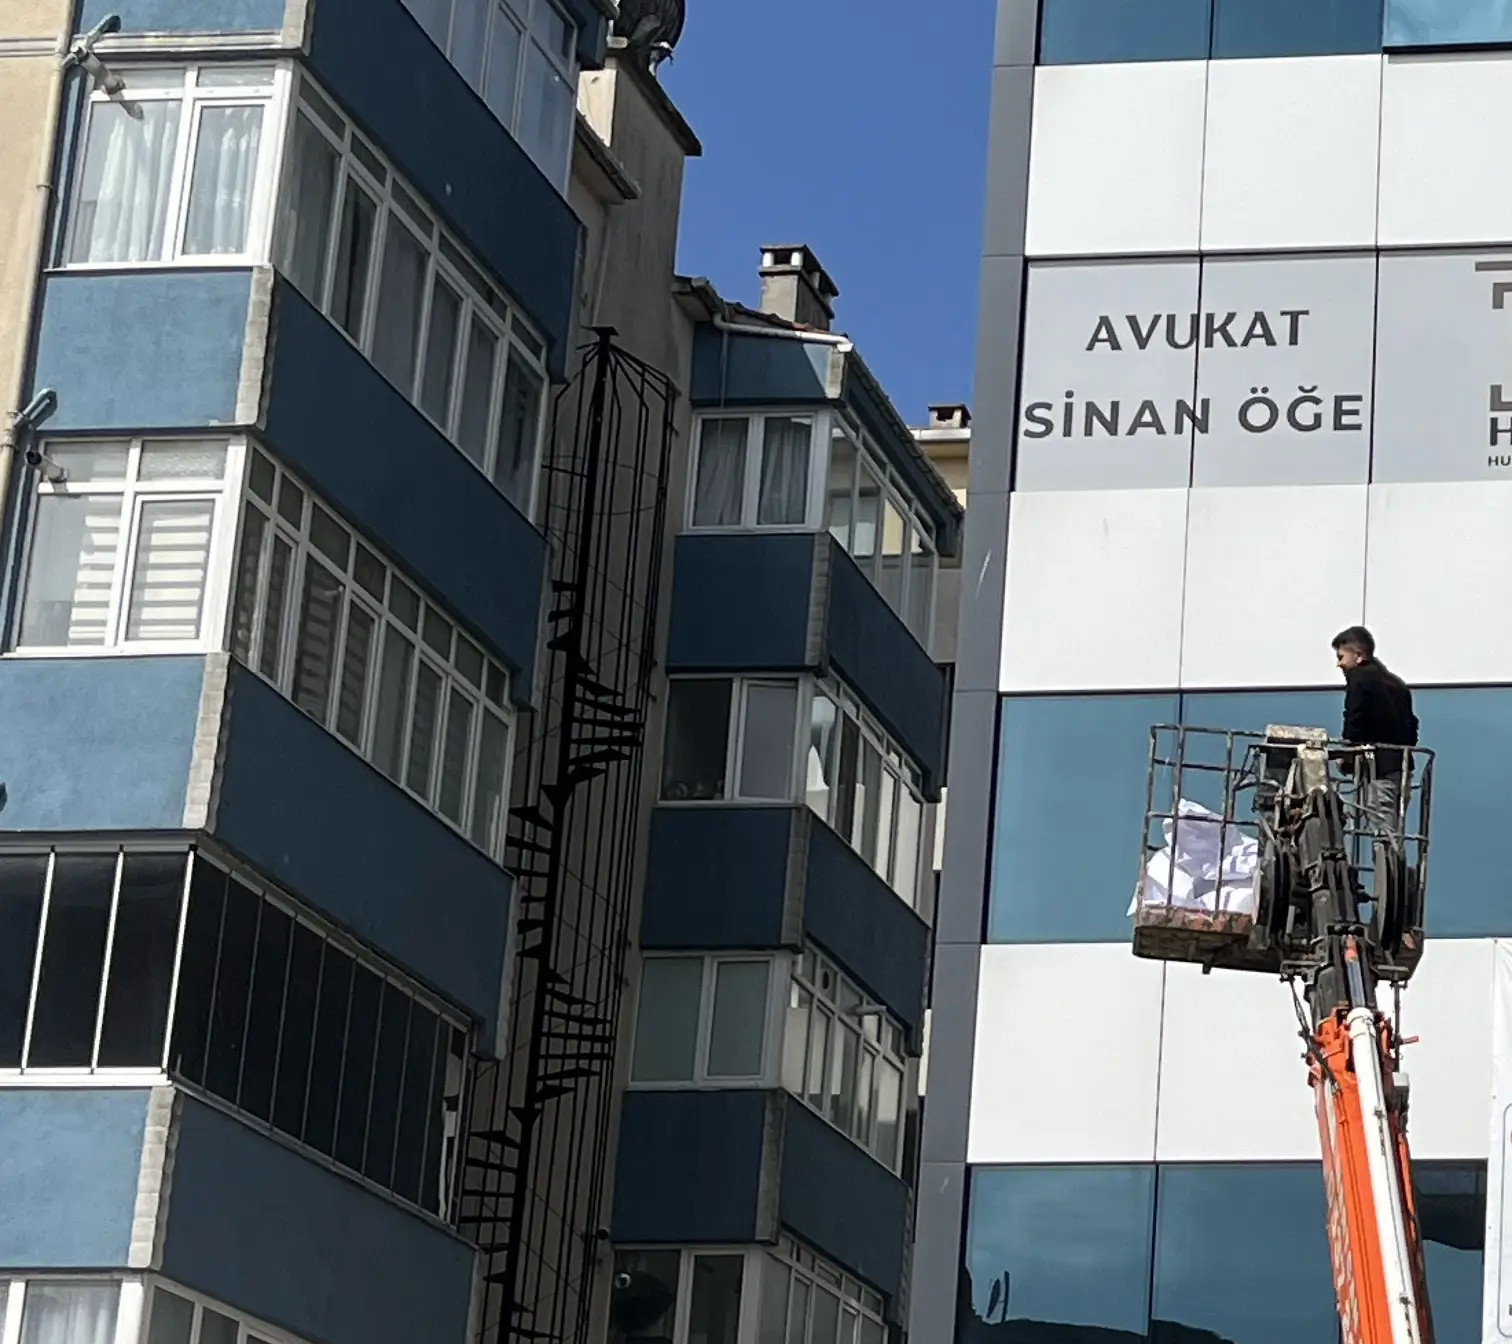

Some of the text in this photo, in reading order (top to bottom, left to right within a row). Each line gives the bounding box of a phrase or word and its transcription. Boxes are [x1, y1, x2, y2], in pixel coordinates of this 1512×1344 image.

[1085, 309, 1310, 352] AVUKAT
[1022, 385, 1364, 439] SİNAN ÖĞE
